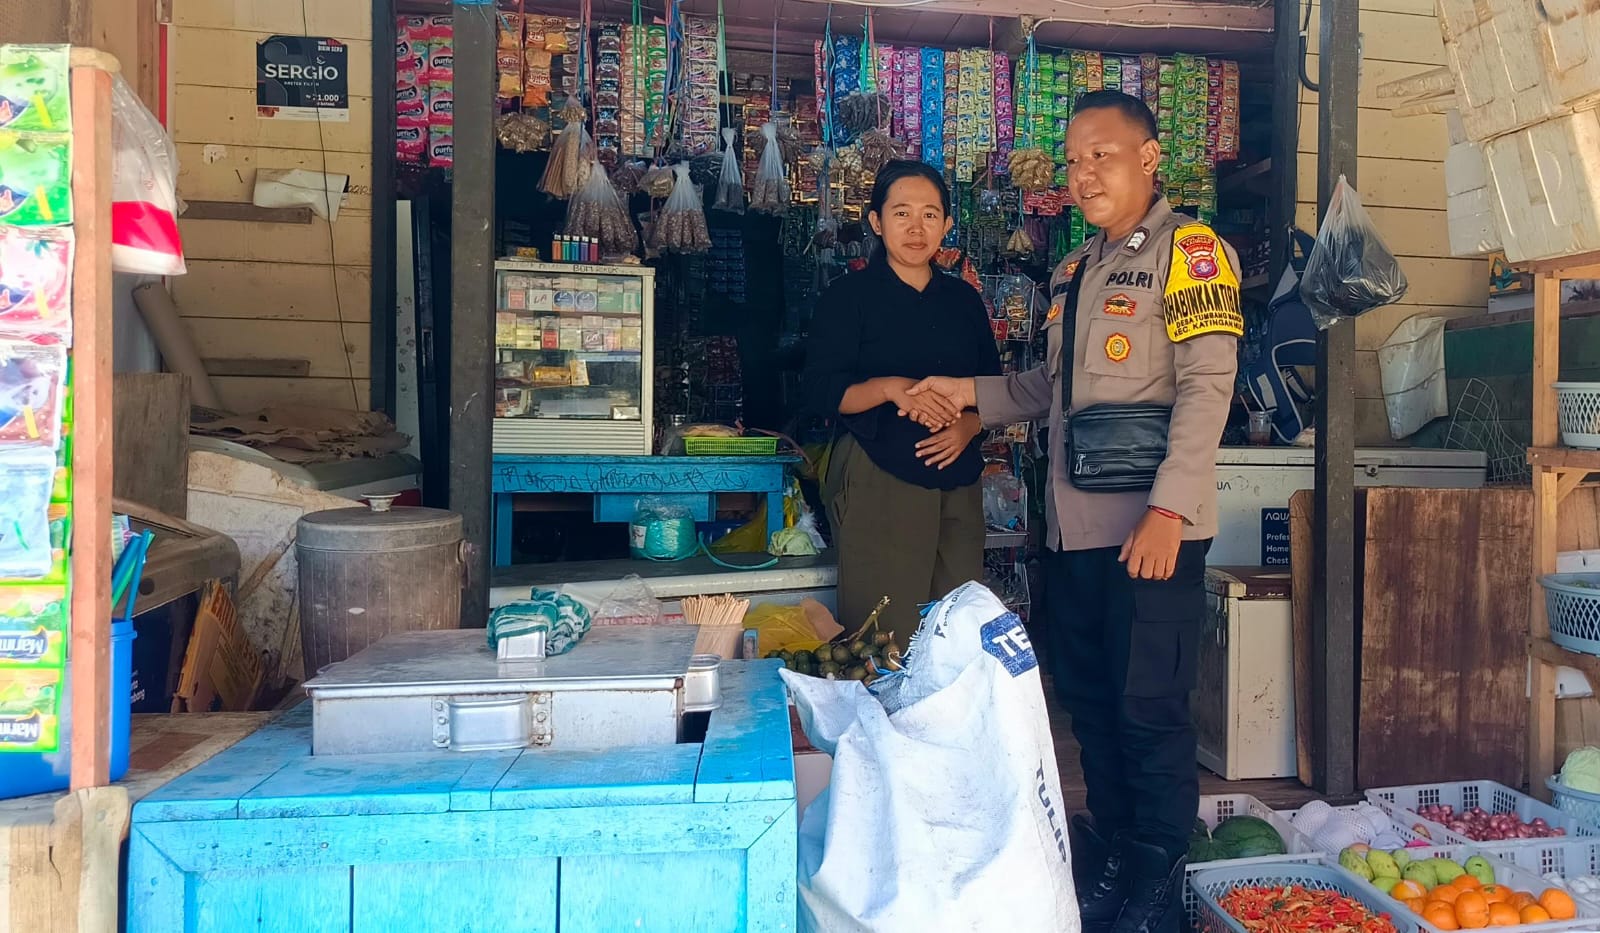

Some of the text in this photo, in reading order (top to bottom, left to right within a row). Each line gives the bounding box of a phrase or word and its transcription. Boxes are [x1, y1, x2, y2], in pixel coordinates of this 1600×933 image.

[265, 63, 339, 81] SERGIO
[1106, 271, 1153, 289] POLRI
[1177, 317, 1196, 329] DESA
[1195, 312, 1228, 323] TUMBANG
[1193, 319, 1232, 331] KATINGAN
[1217, 481, 1231, 490] UA
[1266, 545, 1289, 553] Home
[1266, 556, 1289, 565] Chest
[1036, 758, 1067, 863] TULIP
